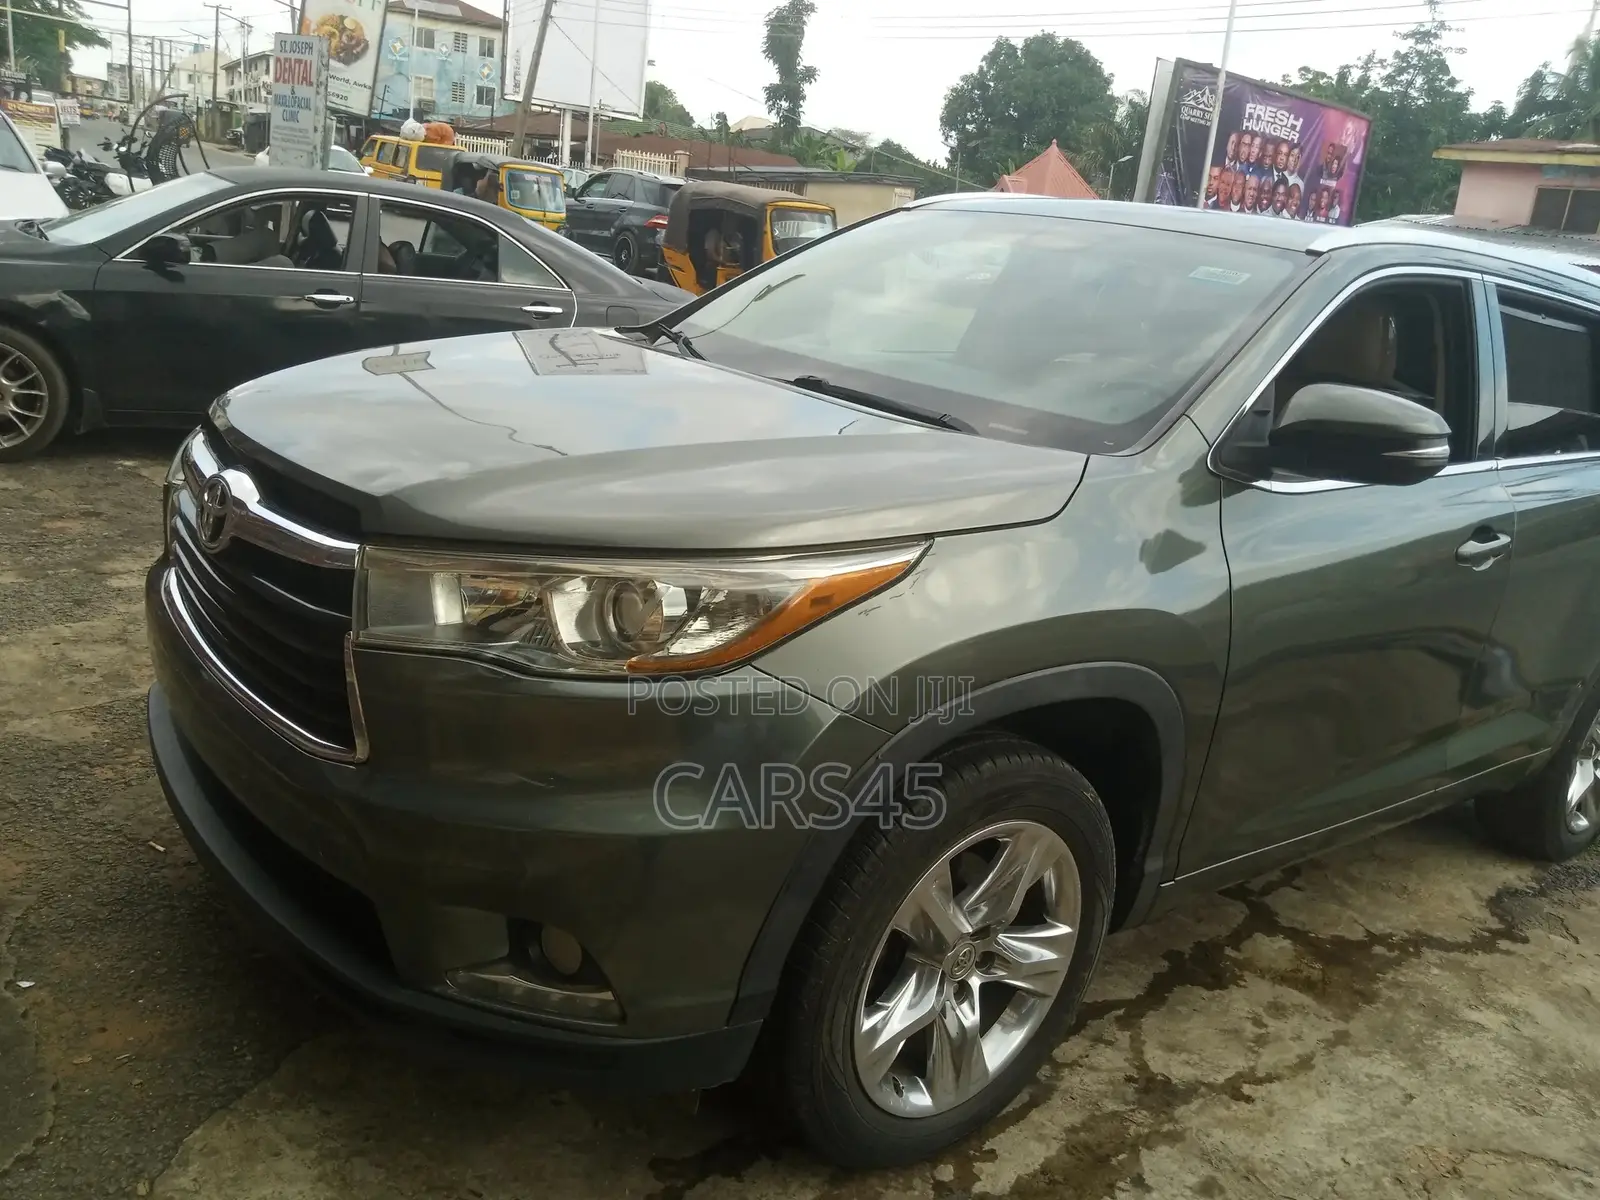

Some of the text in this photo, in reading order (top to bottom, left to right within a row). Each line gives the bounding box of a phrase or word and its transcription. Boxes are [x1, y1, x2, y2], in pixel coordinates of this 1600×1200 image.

[289, 40, 313, 55] JOSEPH
[275, 56, 313, 87] DENTAL
[329, 74, 373, 90] World, Awka
[290, 85, 297, 96] &
[282, 109, 300, 123] CLINIC
[1181, 105, 1204, 119] QUARRY
[1245, 103, 1304, 131] FRESH
[1242, 118, 1300, 143] HUNGER
